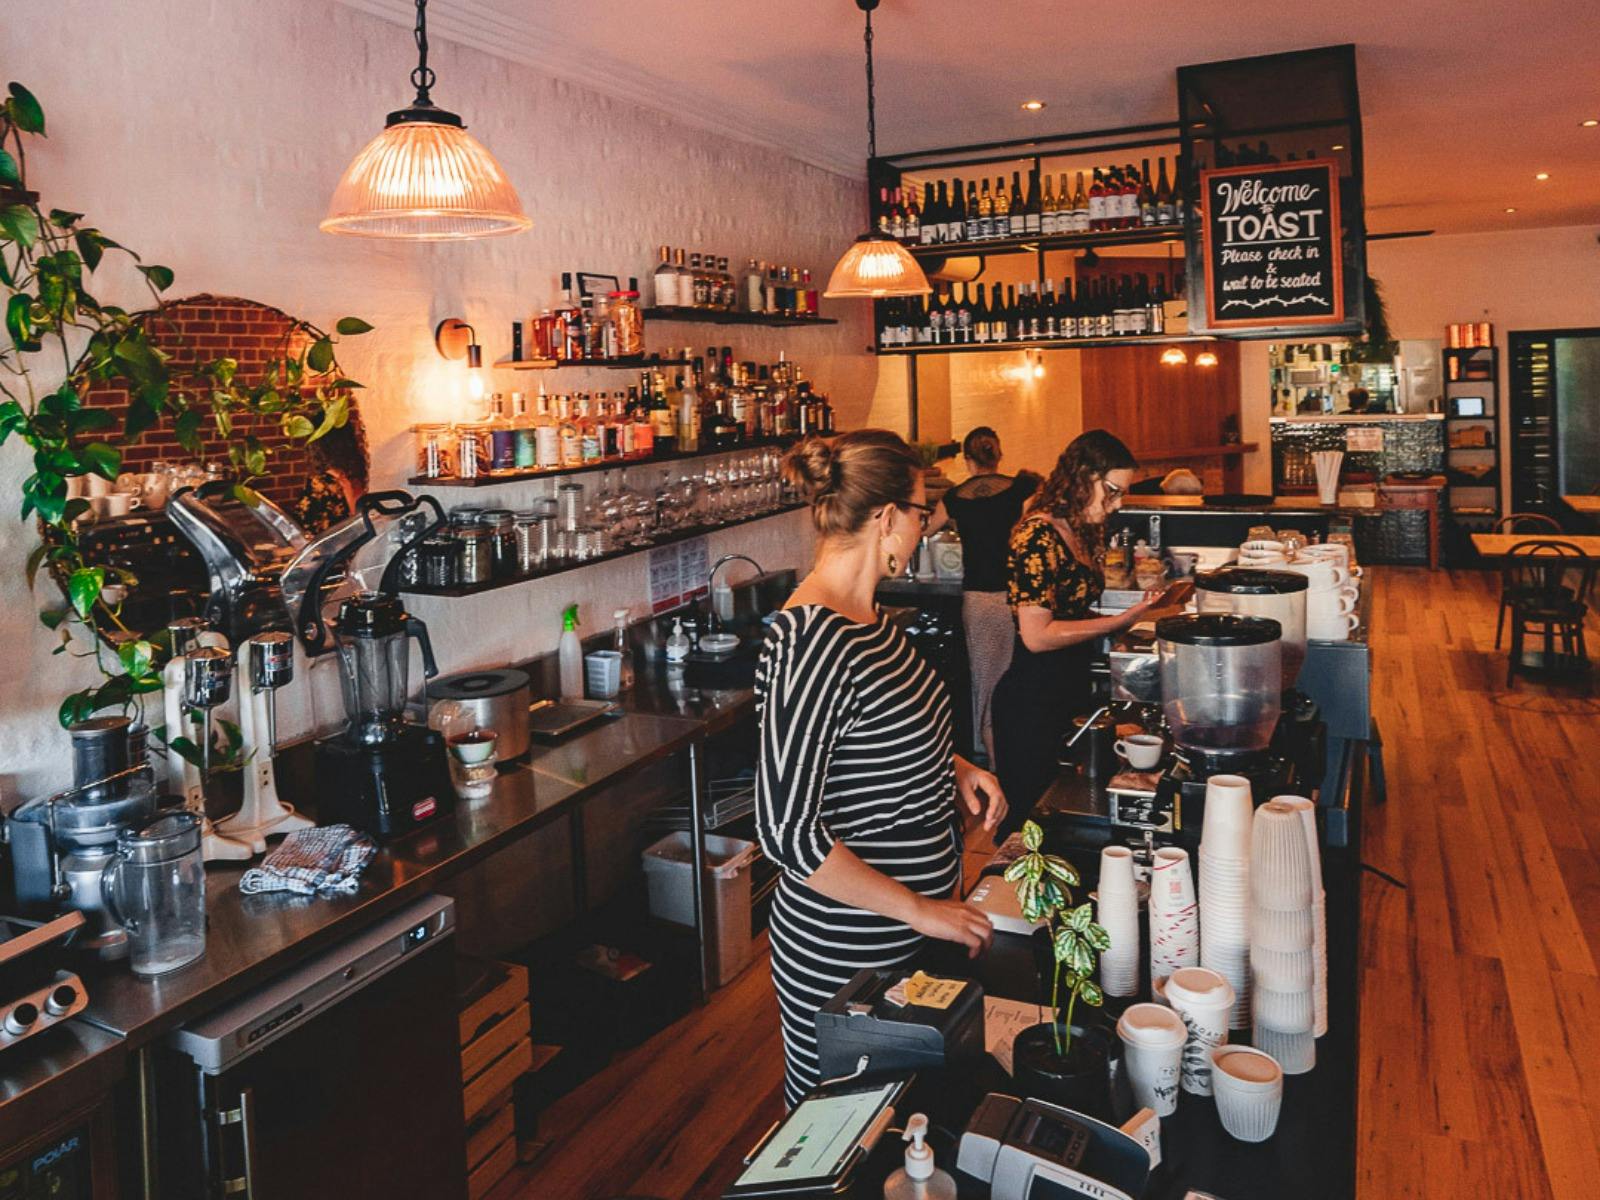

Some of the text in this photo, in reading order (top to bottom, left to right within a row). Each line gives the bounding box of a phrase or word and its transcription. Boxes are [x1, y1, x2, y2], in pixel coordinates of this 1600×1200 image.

[1217, 180, 1320, 215] Welcome
[1218, 209, 1323, 242] TOAST
[1221, 246, 1319, 265] Please check in
[1266, 262, 1277, 274] &
[1223, 272, 1321, 291] wait to be seated
